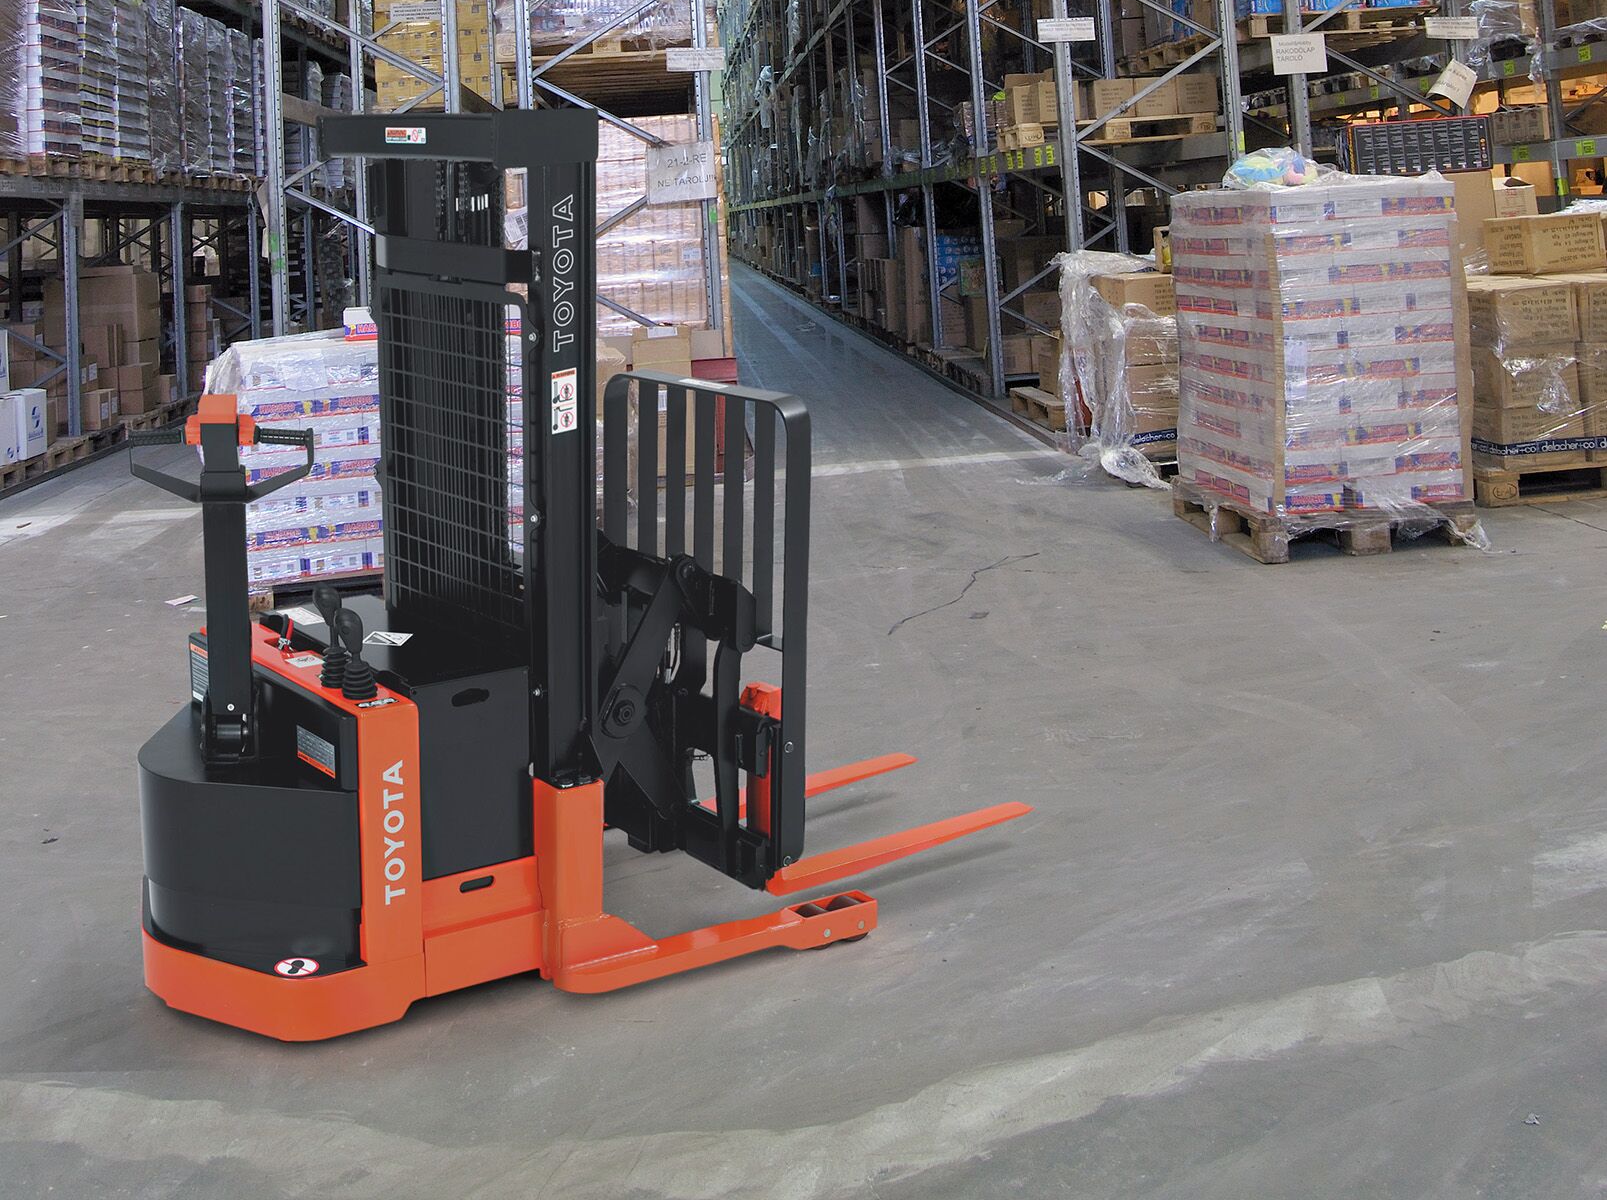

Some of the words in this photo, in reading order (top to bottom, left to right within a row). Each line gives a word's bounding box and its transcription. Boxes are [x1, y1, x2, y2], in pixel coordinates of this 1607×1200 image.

[667, 153, 707, 168] 21-2-RE
[657, 179, 671, 188] NE
[552, 194, 575, 353] TOYOTA
[1541, 440, 1595, 452] delacher+co
[383, 760, 406, 905] TOYOTA
